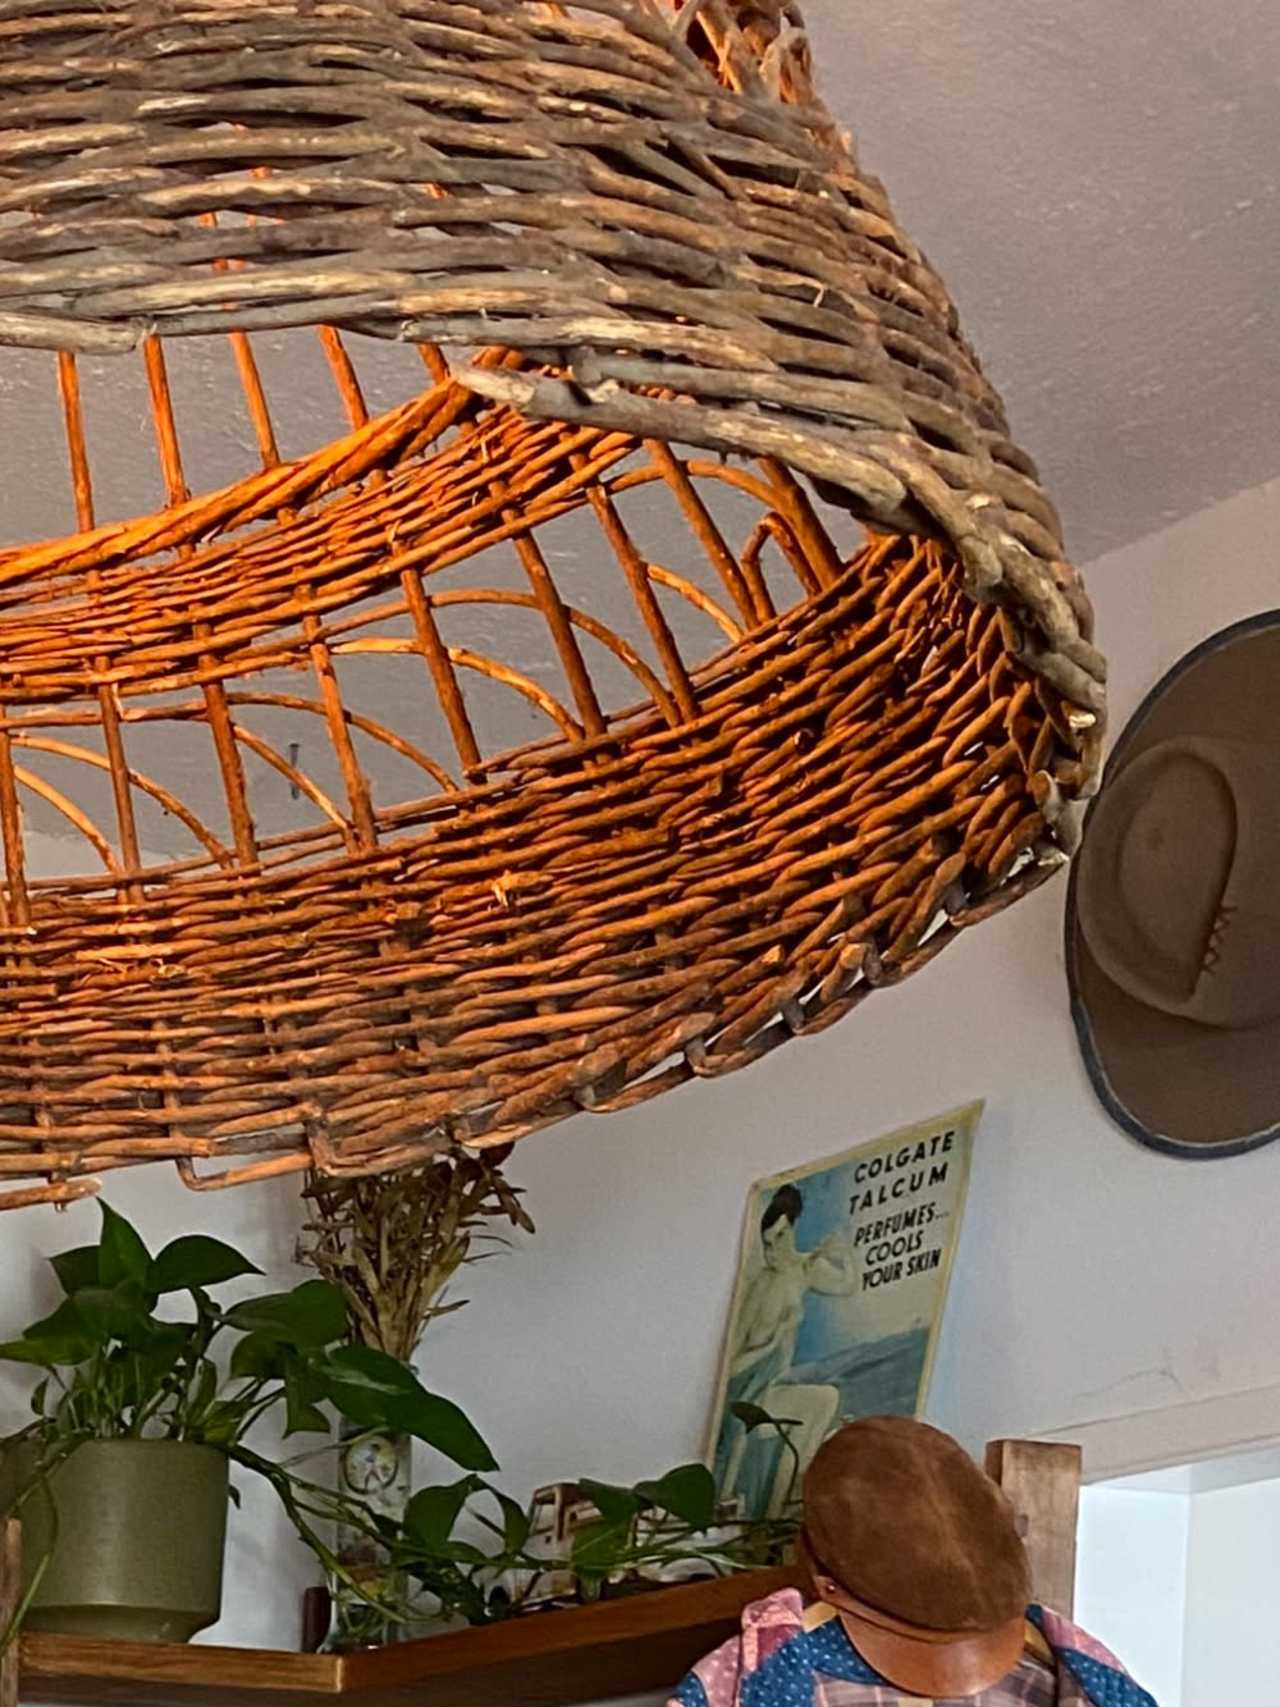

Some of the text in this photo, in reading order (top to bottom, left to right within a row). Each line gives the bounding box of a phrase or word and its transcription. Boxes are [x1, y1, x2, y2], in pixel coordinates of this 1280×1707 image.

[853, 1131, 956, 1184] COLGATE
[849, 1162, 948, 1215] TALCUM
[862, 1249, 942, 1291] YOUR SKIN
[865, 1230, 923, 1266] COOLS
